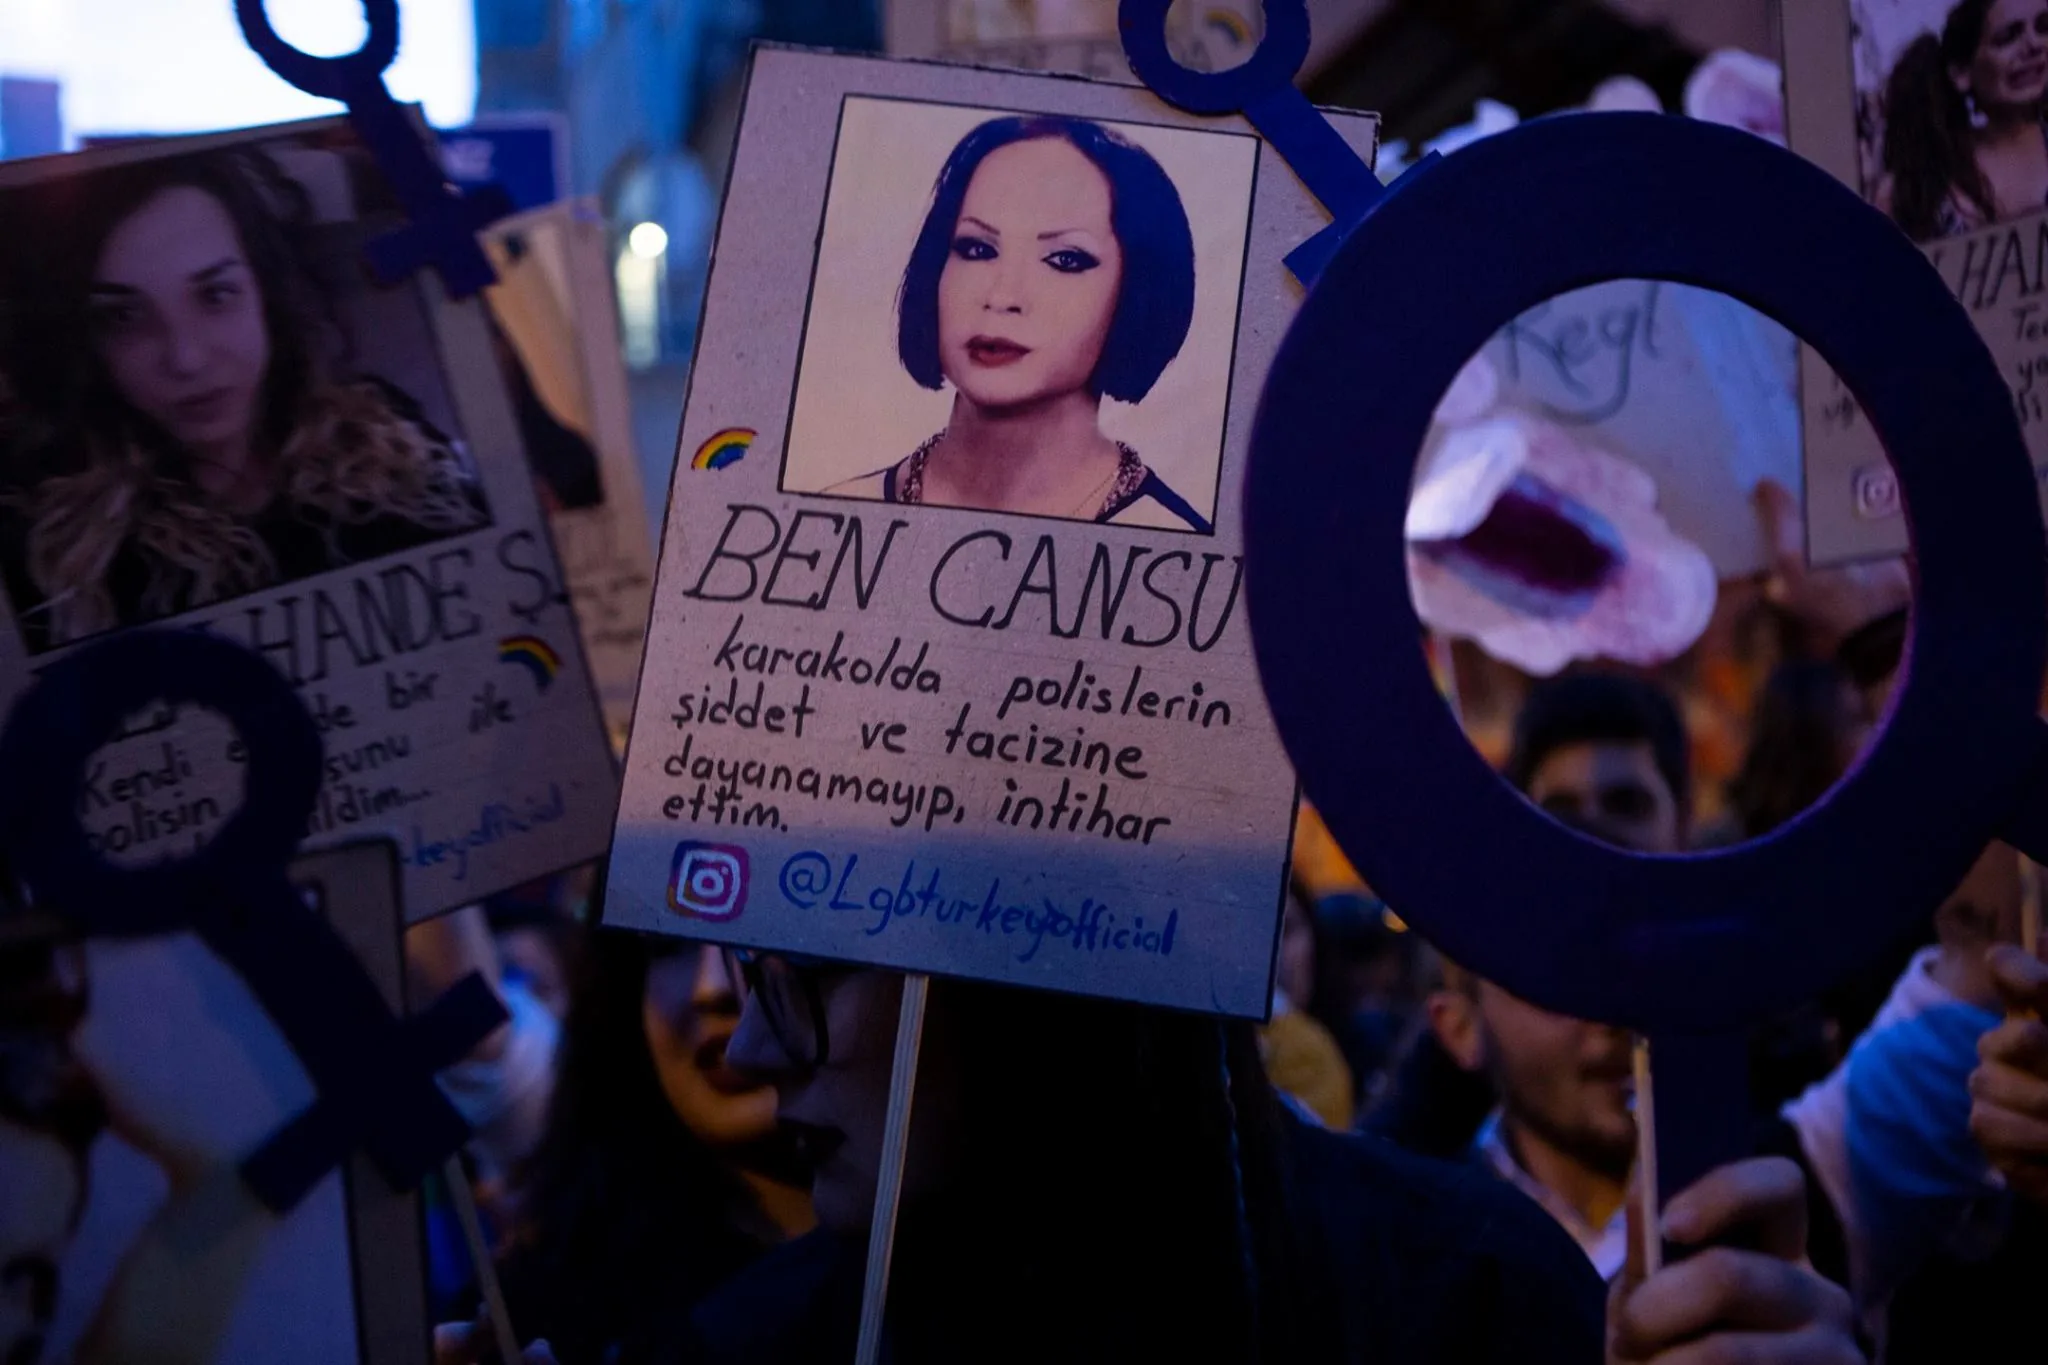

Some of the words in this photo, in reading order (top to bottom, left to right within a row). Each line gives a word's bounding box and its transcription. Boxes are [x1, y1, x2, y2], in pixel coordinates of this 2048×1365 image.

[248, 547, 482, 688] HANDE
[682, 504, 909, 611] BEN
[929, 529, 1243, 654] CANSU
[669, 677, 815, 738] şiddet
[861, 721, 908, 754] ve
[944, 701, 1148, 781] tacizine
[713, 613, 943, 696] karakolda
[996, 658, 1232, 729] polislerin
[995, 777, 1172, 846] intihar
